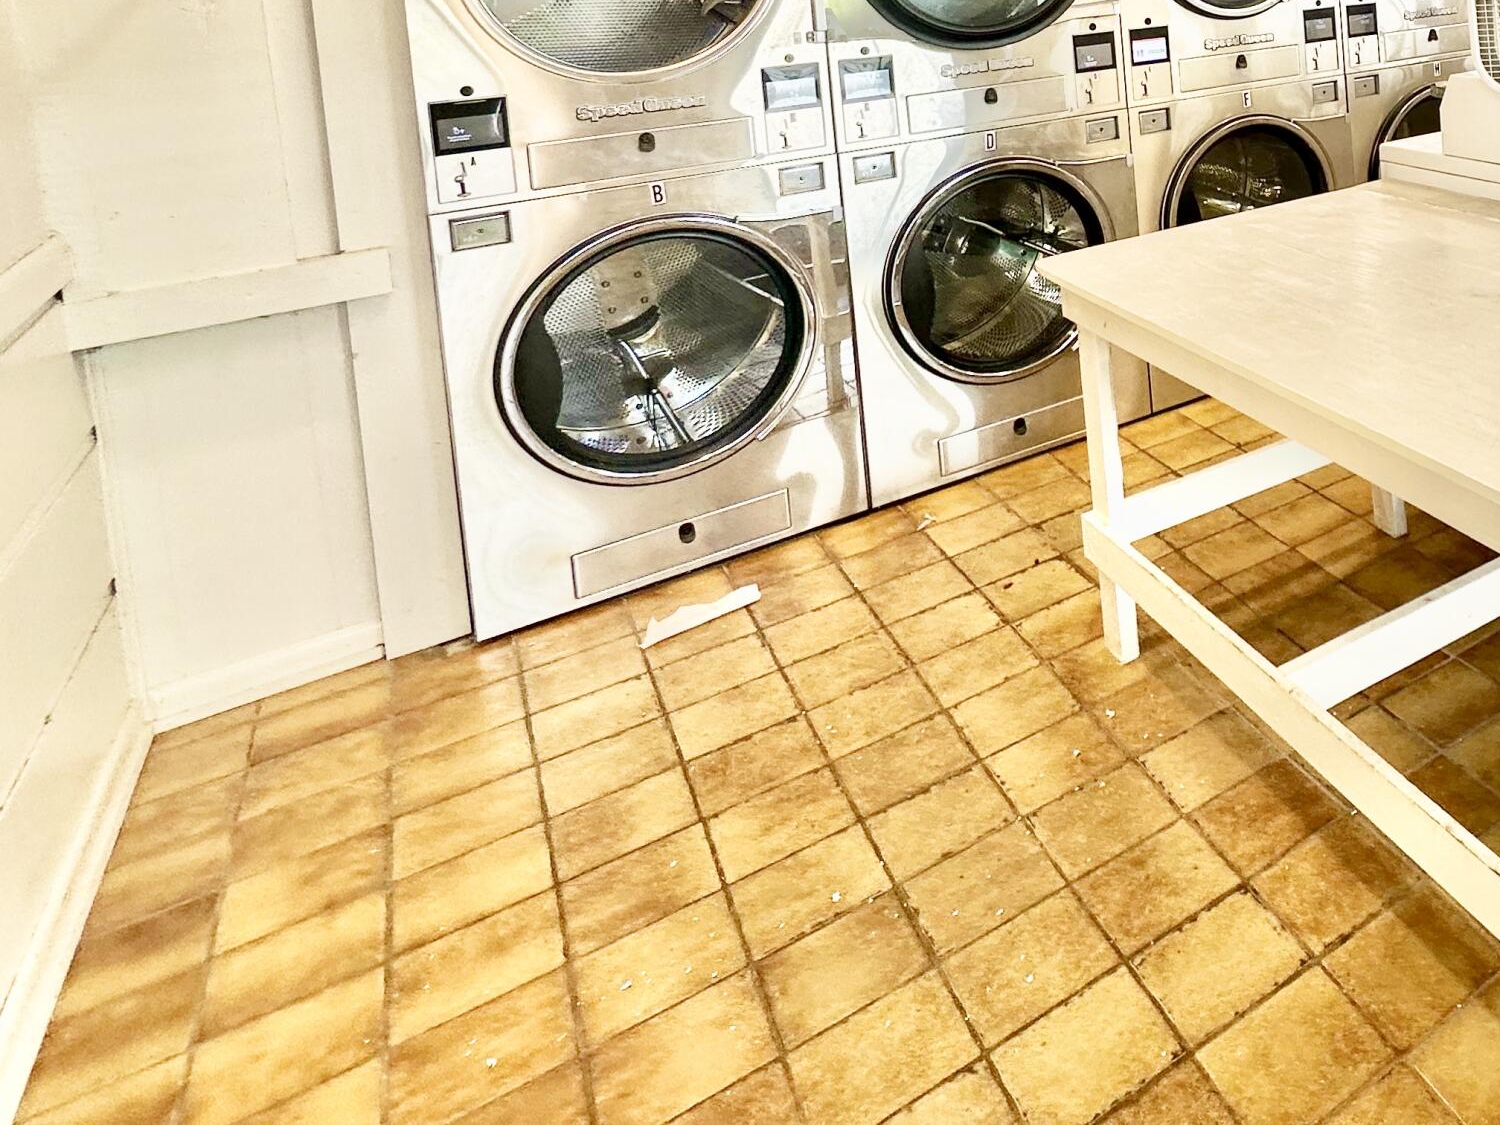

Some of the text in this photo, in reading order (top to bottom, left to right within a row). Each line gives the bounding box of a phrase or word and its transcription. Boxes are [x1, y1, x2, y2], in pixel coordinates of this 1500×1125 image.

[1204, 32, 1274, 50] Speed Queen
[941, 59, 989, 79] Speed
[1435, 63, 1440, 75] H
[1243, 92, 1250, 107] F
[576, 99, 643, 122] Speed
[987, 133, 994, 149] D
[652, 184, 663, 203] B
